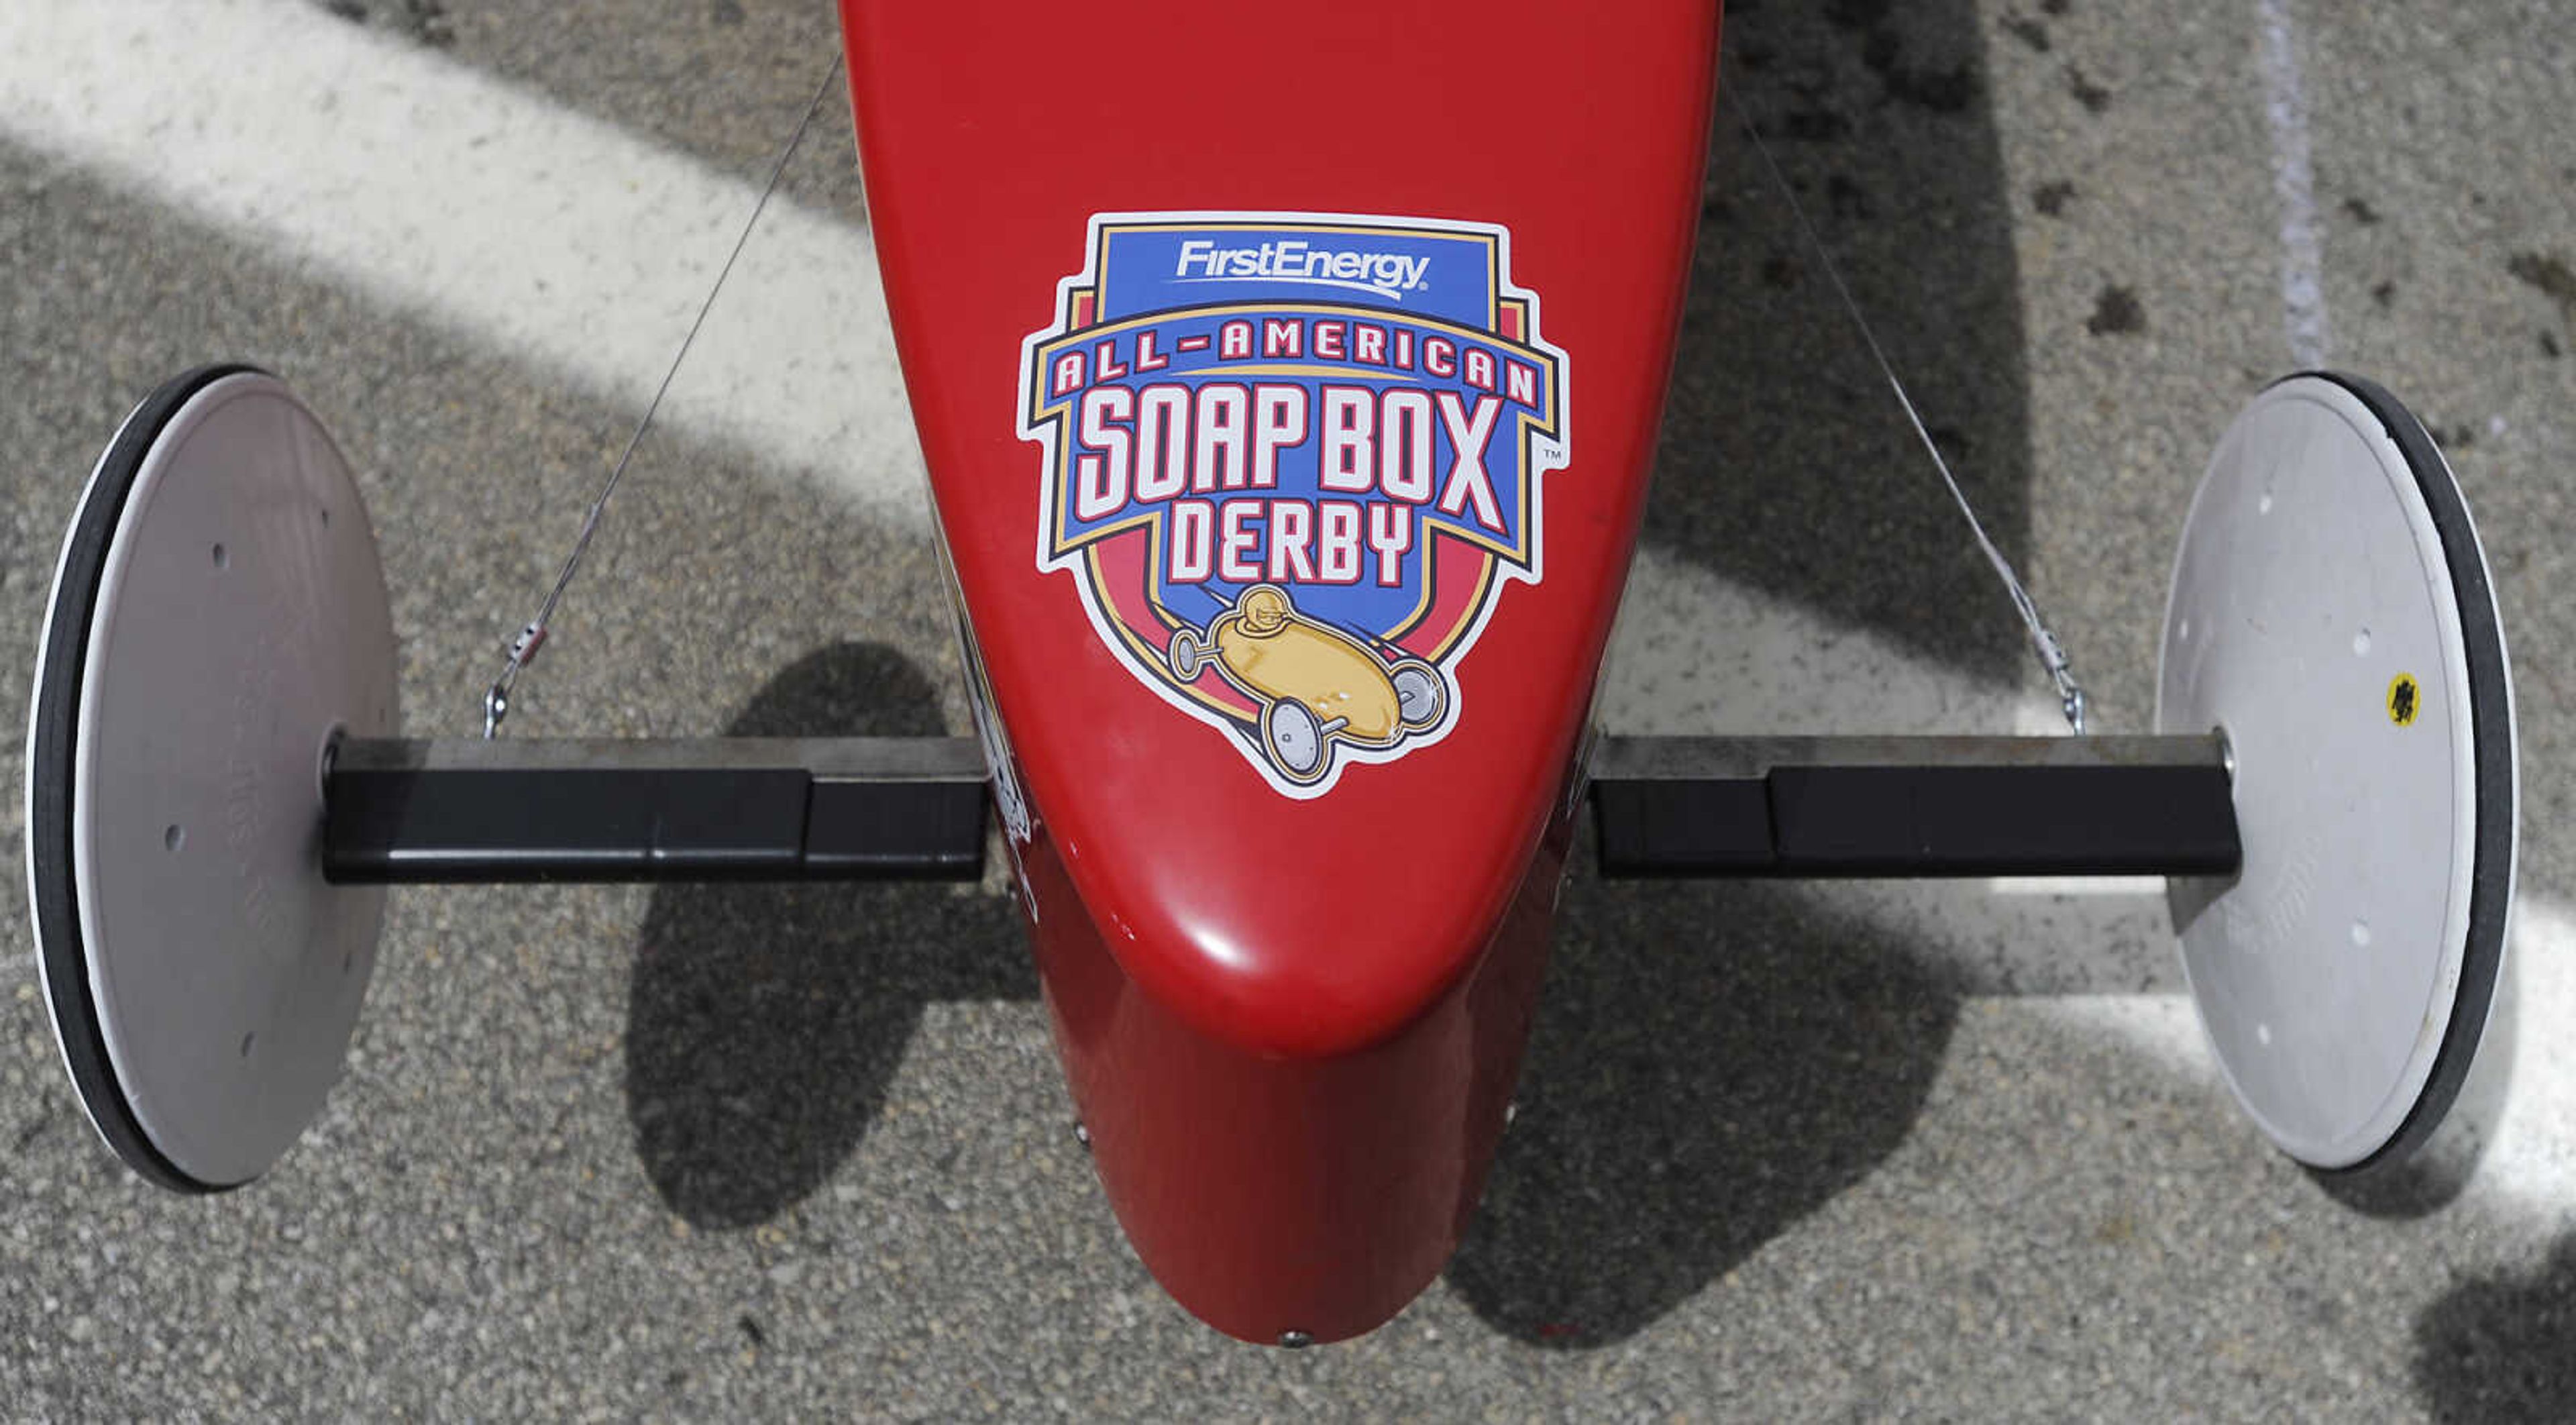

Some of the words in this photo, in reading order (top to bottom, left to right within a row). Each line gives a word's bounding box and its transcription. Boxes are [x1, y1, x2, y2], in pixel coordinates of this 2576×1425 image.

[1176, 240, 1430, 290] FirstEnergy
[1053, 318, 1538, 409] ALL-AMERICAN
[1075, 384, 1309, 523] SOAP
[1319, 384, 1509, 535] BOX
[1167, 498, 1412, 586] DERBY
